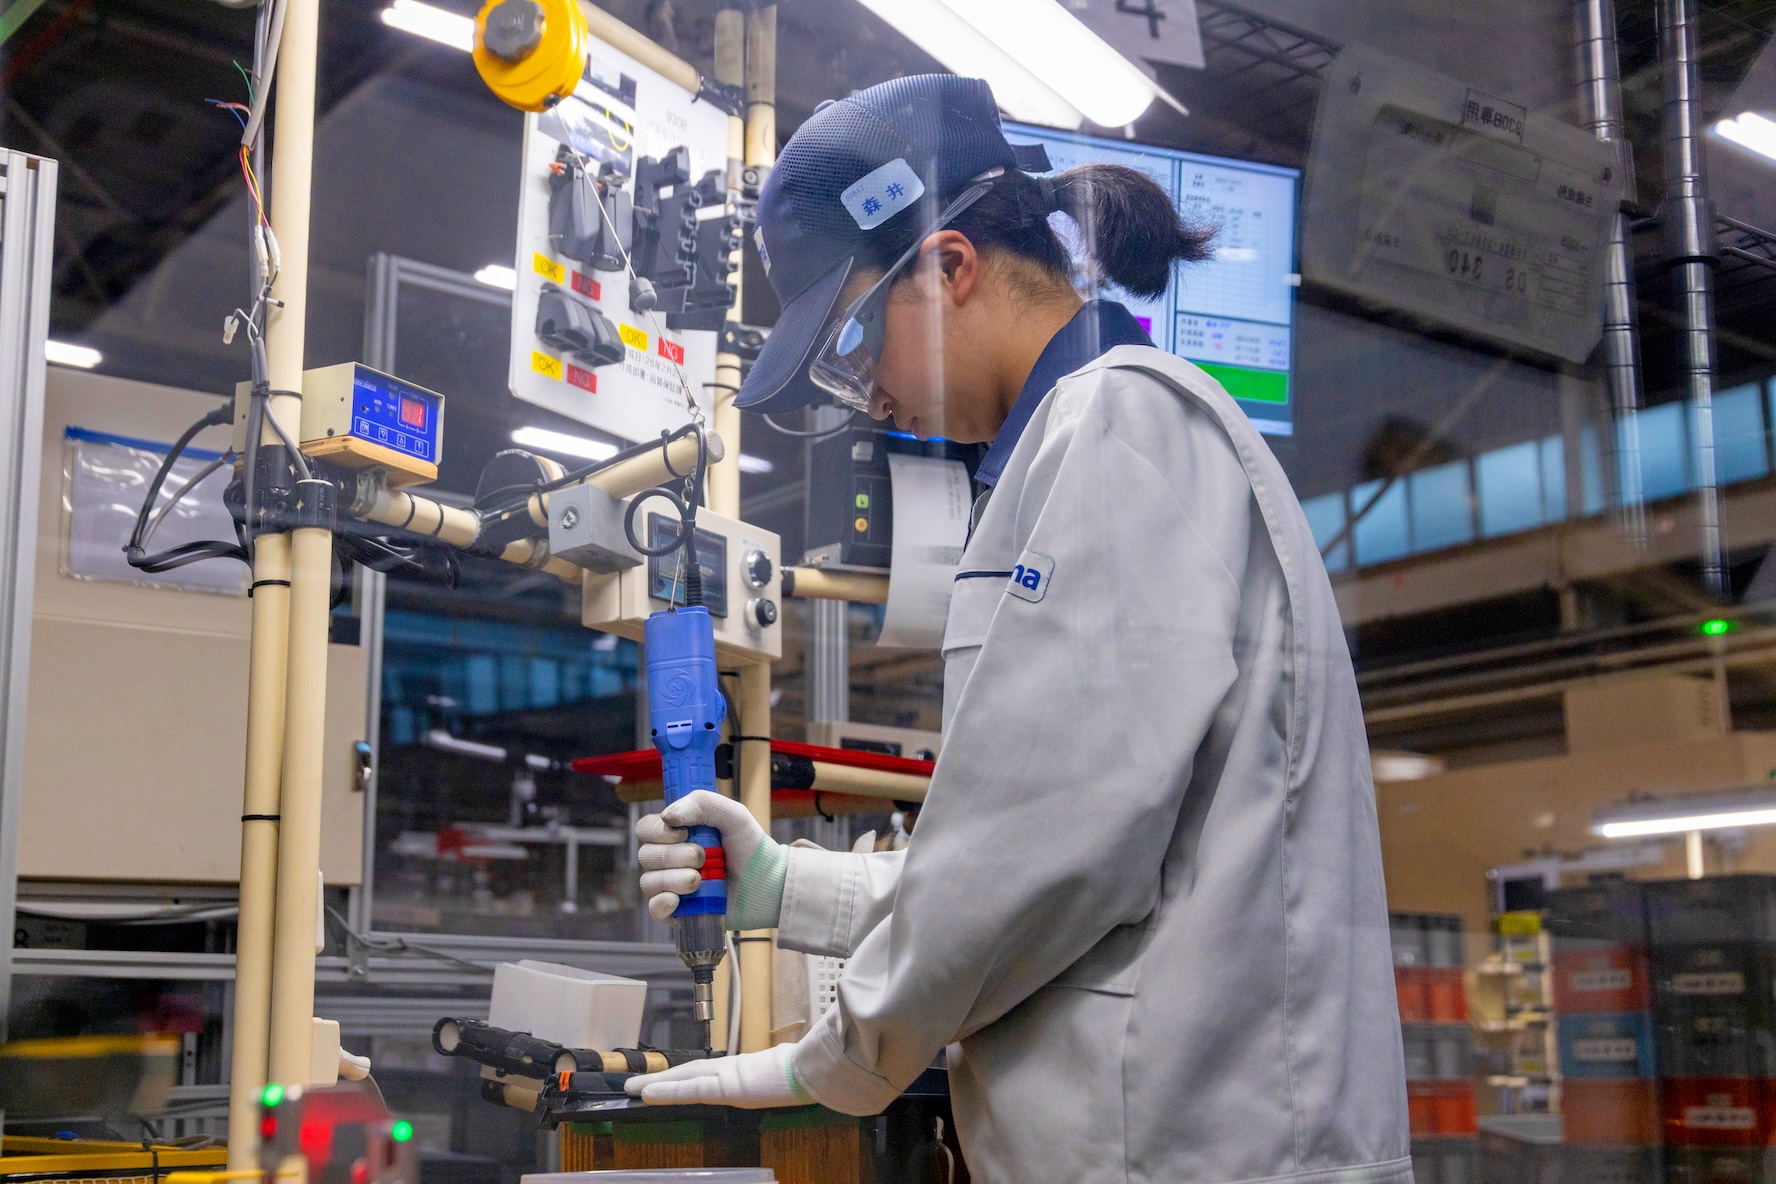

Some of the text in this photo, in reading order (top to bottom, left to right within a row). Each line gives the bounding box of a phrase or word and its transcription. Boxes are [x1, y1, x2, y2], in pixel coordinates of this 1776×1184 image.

[1116, 0, 1166, 38] 4
[861, 182, 905, 217] 森井
[541, 260, 557, 278] OK
[578, 274, 594, 296] NG
[626, 328, 641, 346] OK
[663, 342, 679, 360] NG
[538, 356, 555, 375] OK
[574, 370, 590, 388] NG
